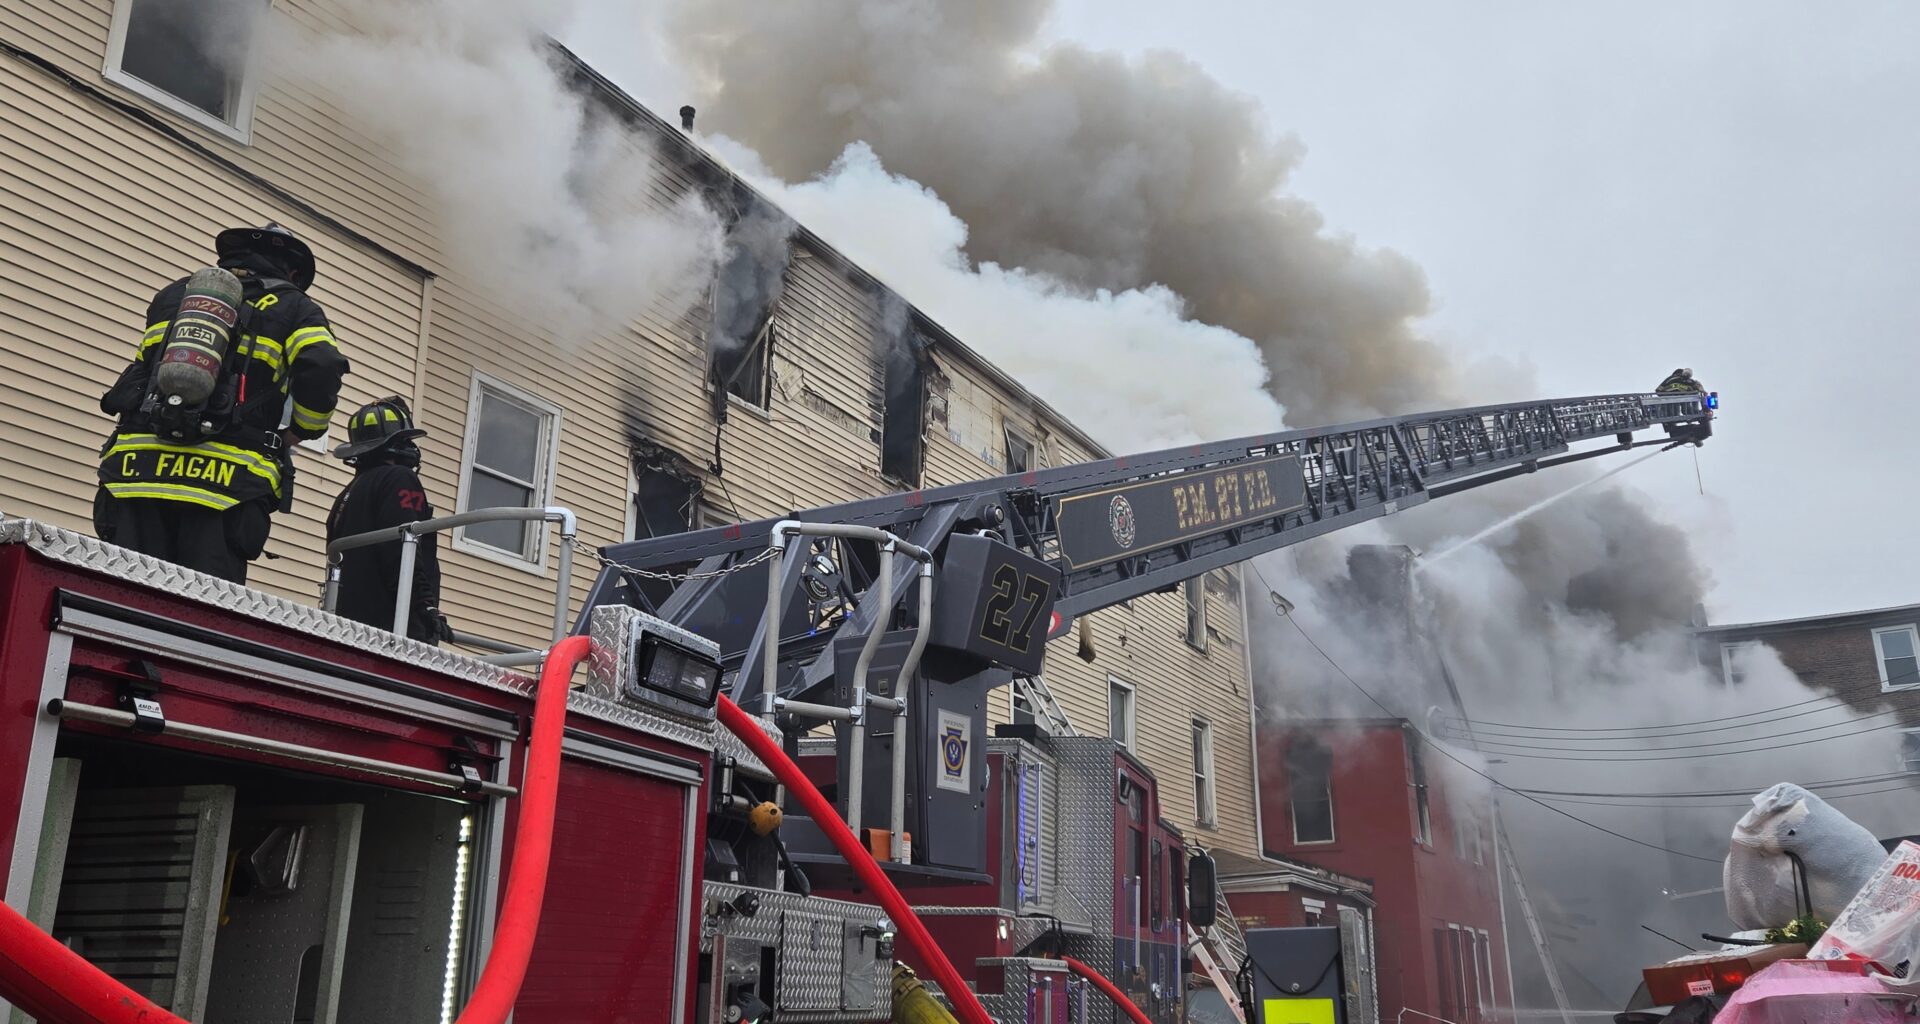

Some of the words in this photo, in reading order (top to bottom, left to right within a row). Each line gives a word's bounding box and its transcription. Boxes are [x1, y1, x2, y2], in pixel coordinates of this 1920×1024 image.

[178, 327, 213, 343] MSA
[122, 452, 140, 476] C.
[155, 453, 235, 487] FAGAN
[398, 489, 424, 512] 27
[980, 563, 1050, 654] 27
